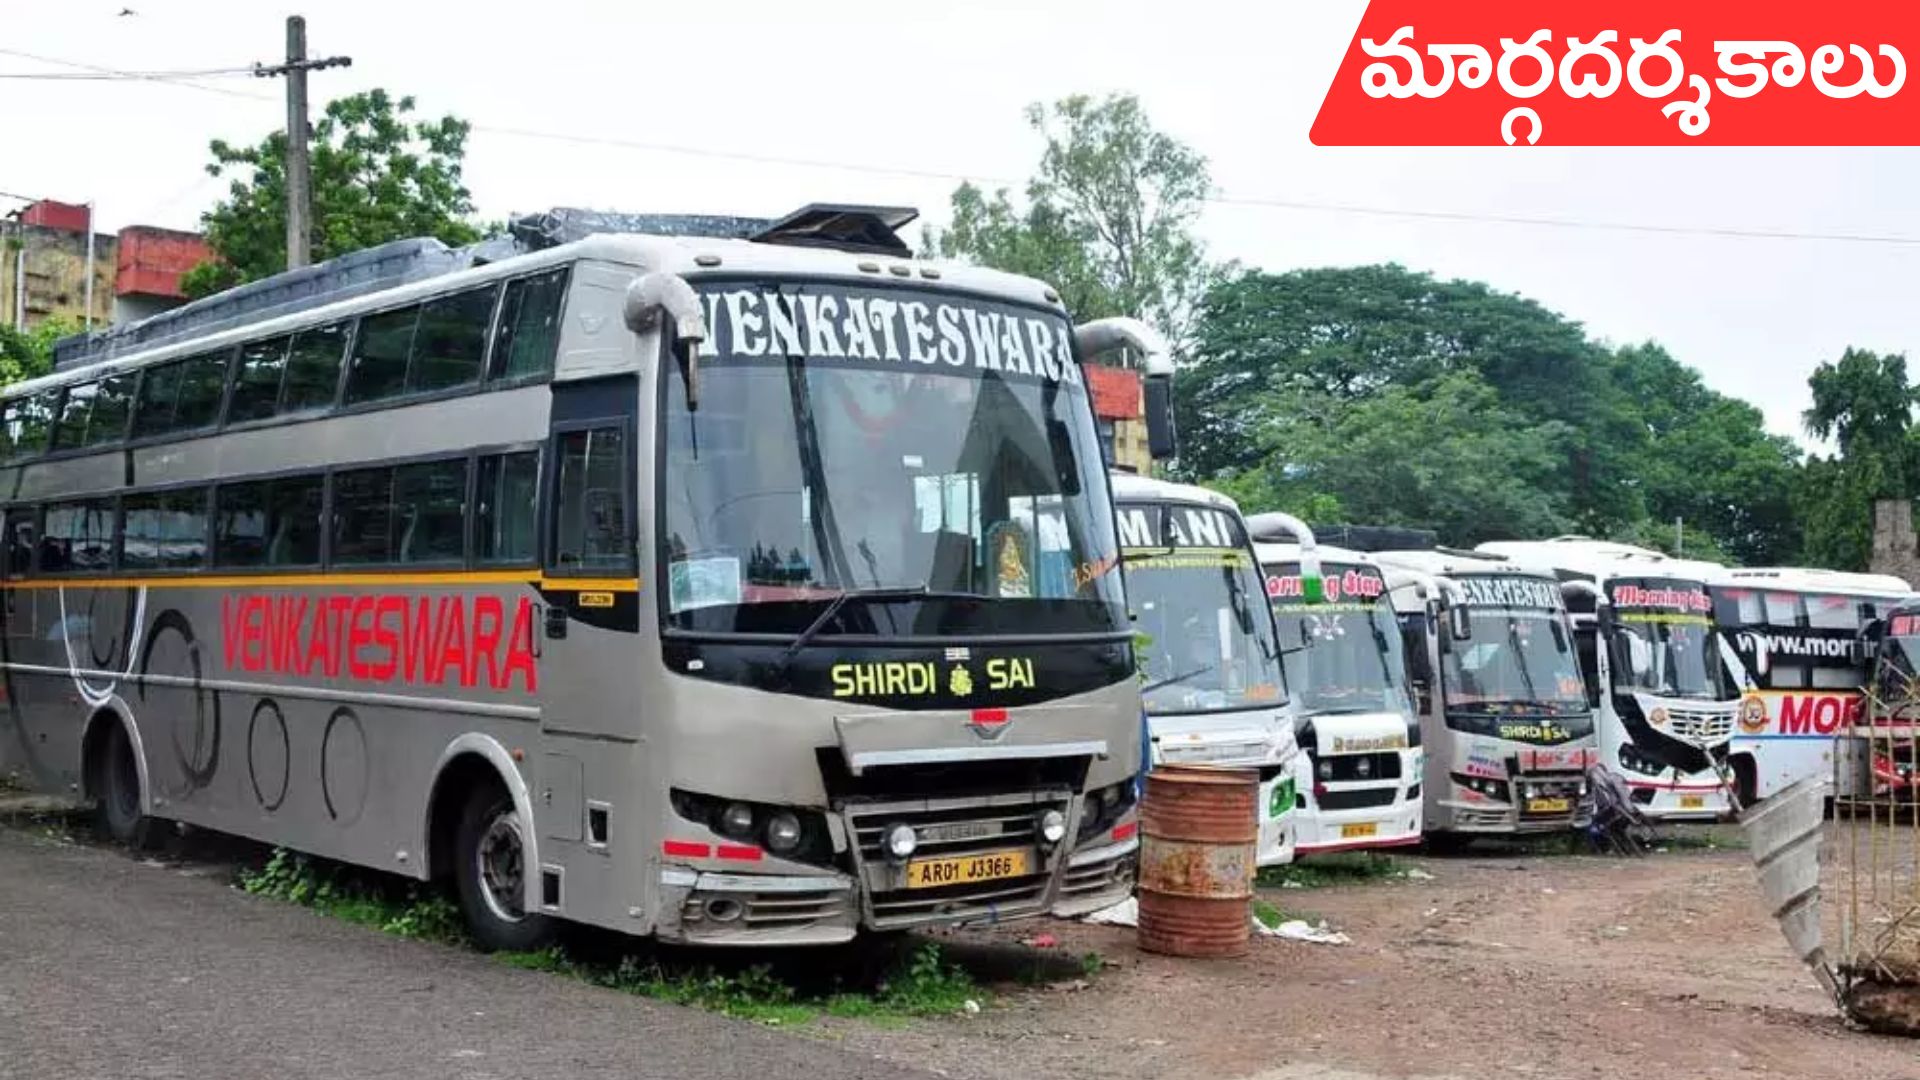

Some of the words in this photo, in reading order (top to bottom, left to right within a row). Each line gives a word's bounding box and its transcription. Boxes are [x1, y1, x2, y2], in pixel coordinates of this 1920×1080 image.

[221, 592, 537, 694] VENKATESWARA
[831, 662, 936, 697] SHIRDI
[986, 657, 1036, 690] SAI
[921, 863, 960, 883] AR01
